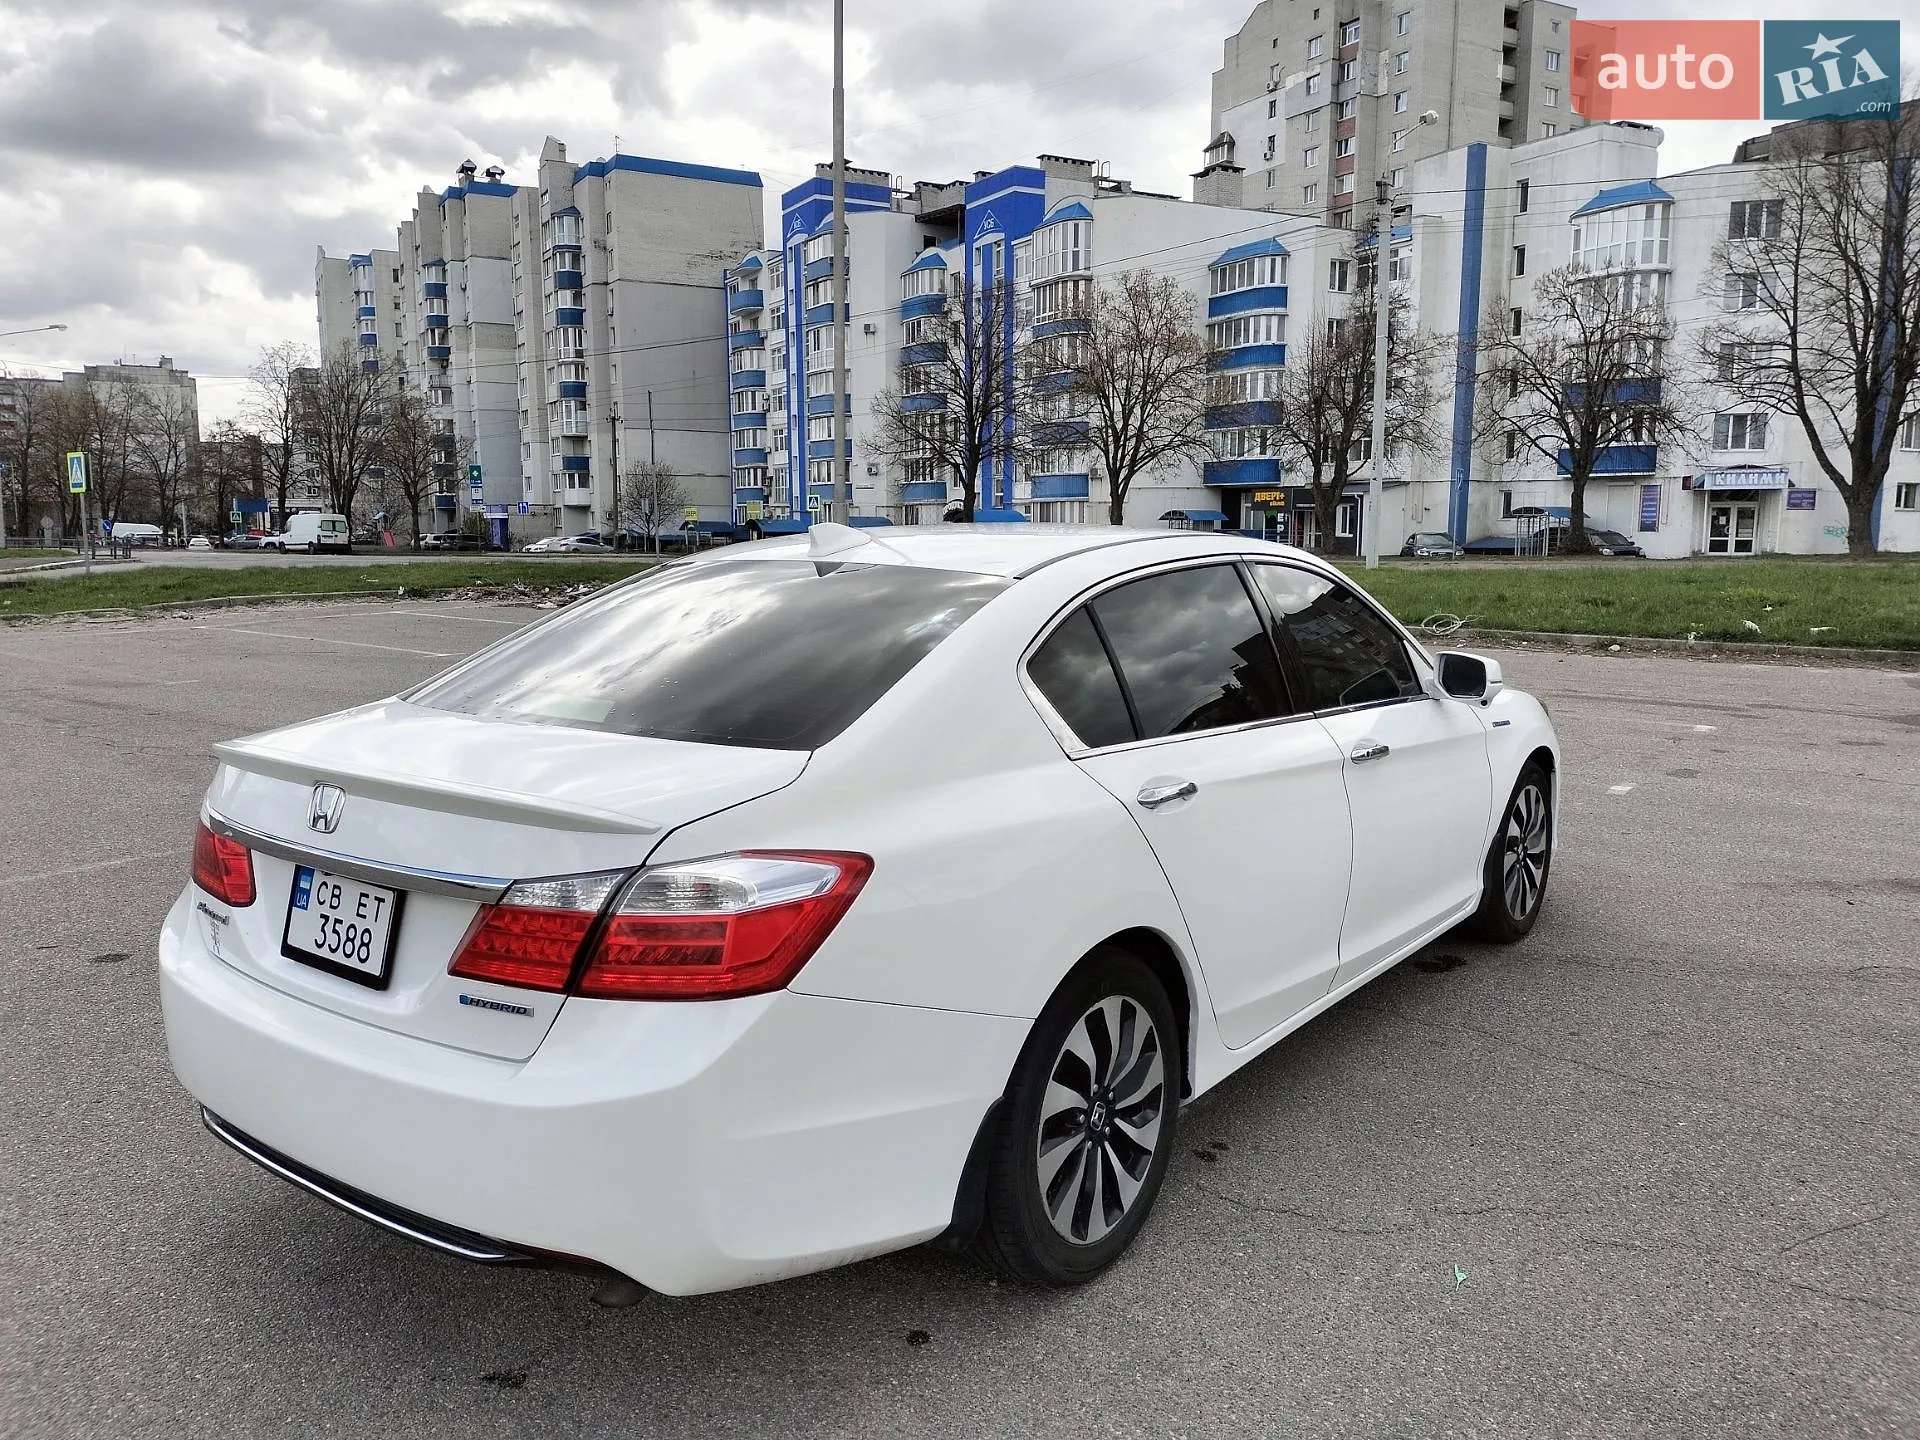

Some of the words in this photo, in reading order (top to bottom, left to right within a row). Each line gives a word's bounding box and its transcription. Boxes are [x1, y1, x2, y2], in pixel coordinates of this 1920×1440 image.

[1715, 472, 1786, 486] КИЛИМИ
[296, 891, 308, 908] UA
[316, 880, 342, 910] CB
[356, 891, 386, 923] ET
[314, 913, 372, 964] 3588
[469, 996, 528, 1015] HYBRID
